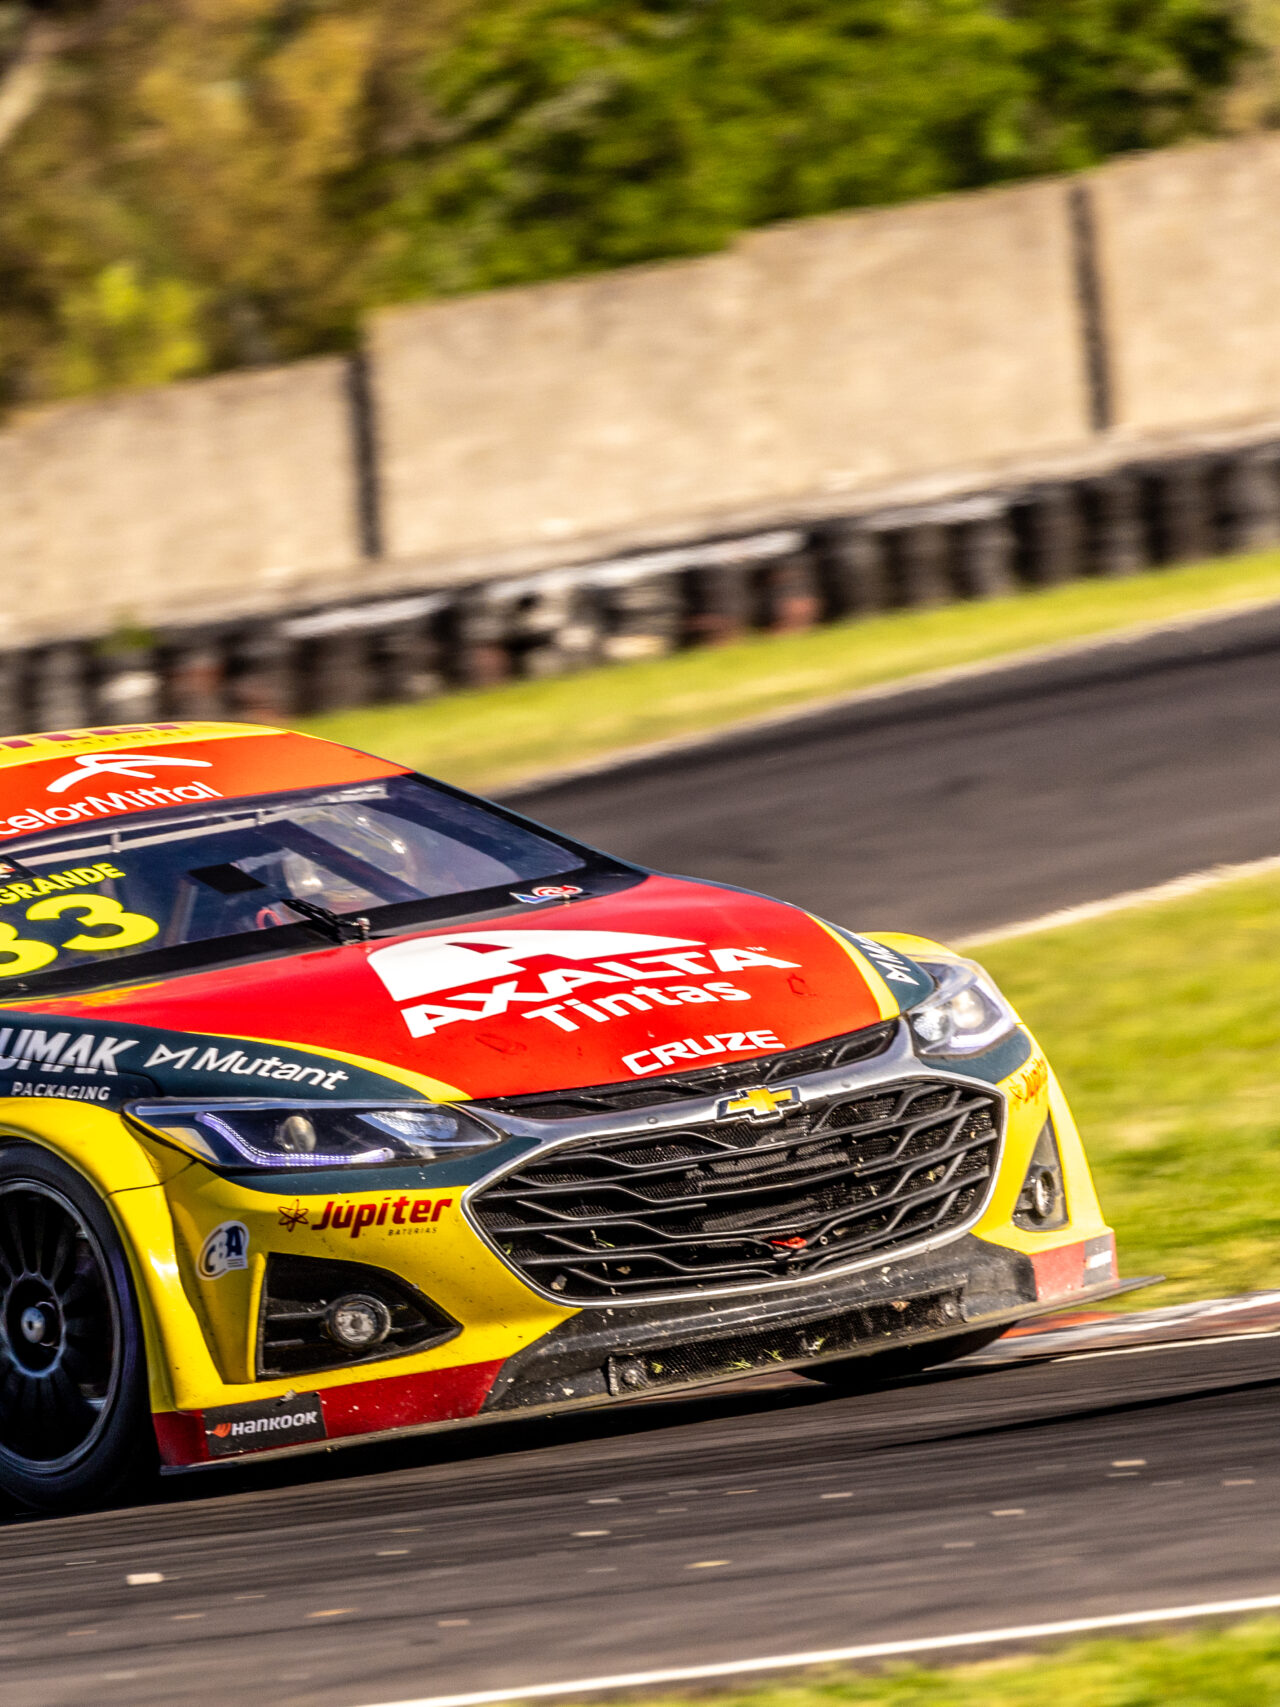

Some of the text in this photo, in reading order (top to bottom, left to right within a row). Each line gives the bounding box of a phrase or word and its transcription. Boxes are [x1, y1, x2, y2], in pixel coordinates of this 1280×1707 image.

[400, 947, 802, 1038] AXALTA
[521, 980, 752, 1032] Tintas
[192, 1046, 350, 1091] Mutant
[621, 1029, 786, 1075] CRUZE
[11, 1081, 111, 1101] PACKAGING
